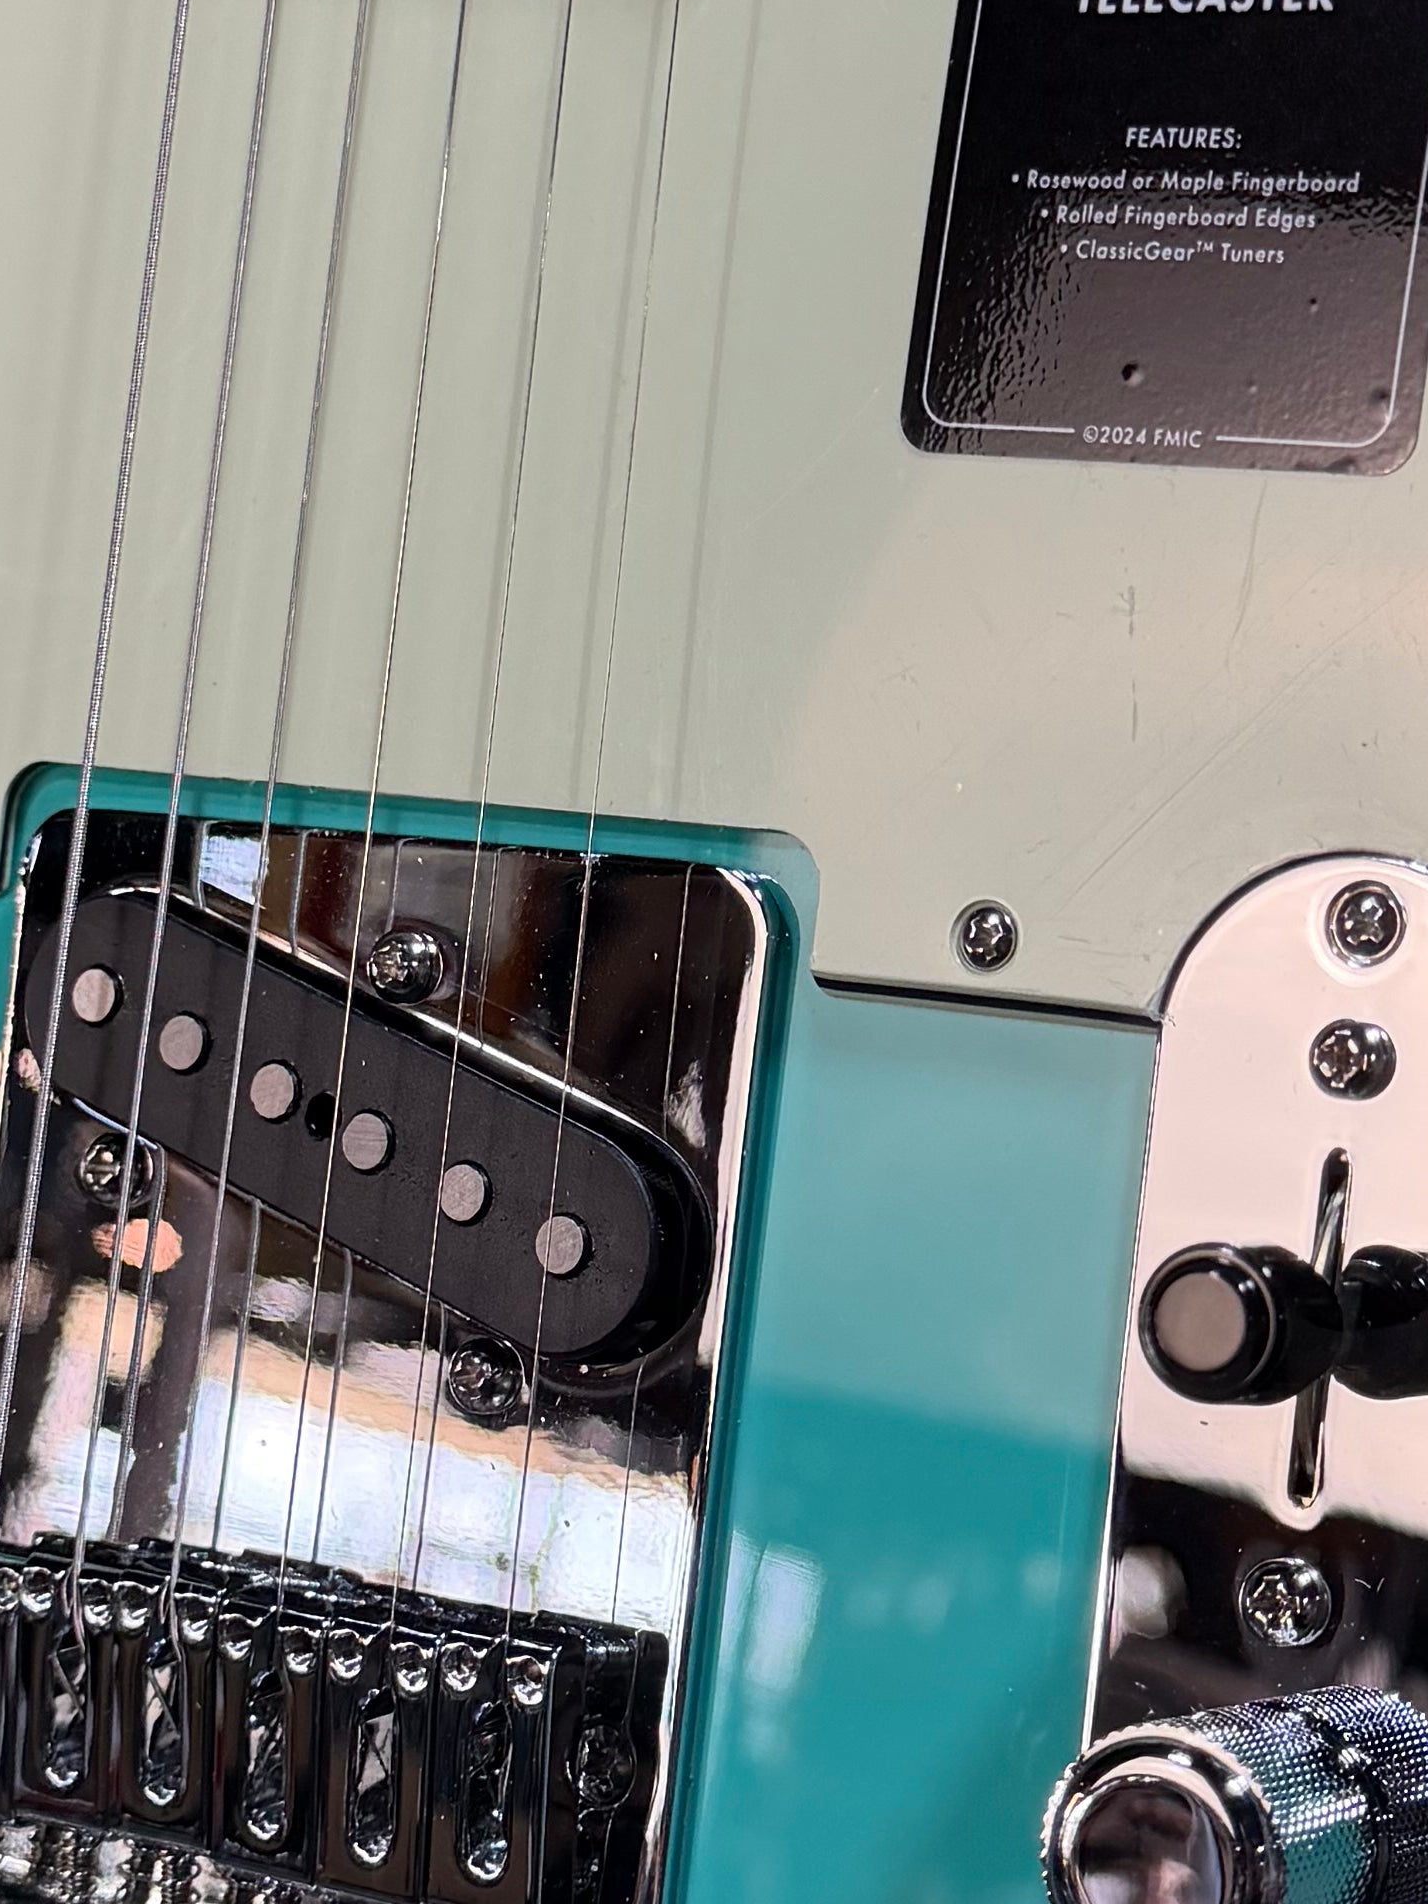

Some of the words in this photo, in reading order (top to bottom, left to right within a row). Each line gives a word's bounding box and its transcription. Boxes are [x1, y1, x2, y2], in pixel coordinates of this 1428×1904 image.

[1124, 126, 1243, 150] FEATURES:
[1026, 168, 1128, 190] Rosewood
[1131, 176, 1155, 190] or
[1160, 169, 1225, 196] Maple
[1231, 170, 1361, 197] Fingerboard
[1055, 203, 1119, 225] Rolled
[1123, 205, 1249, 231] Fingerboard
[1254, 207, 1316, 233] Edges
[1220, 242, 1285, 264] Tuners
[1153, 427, 1203, 449] FMIC
